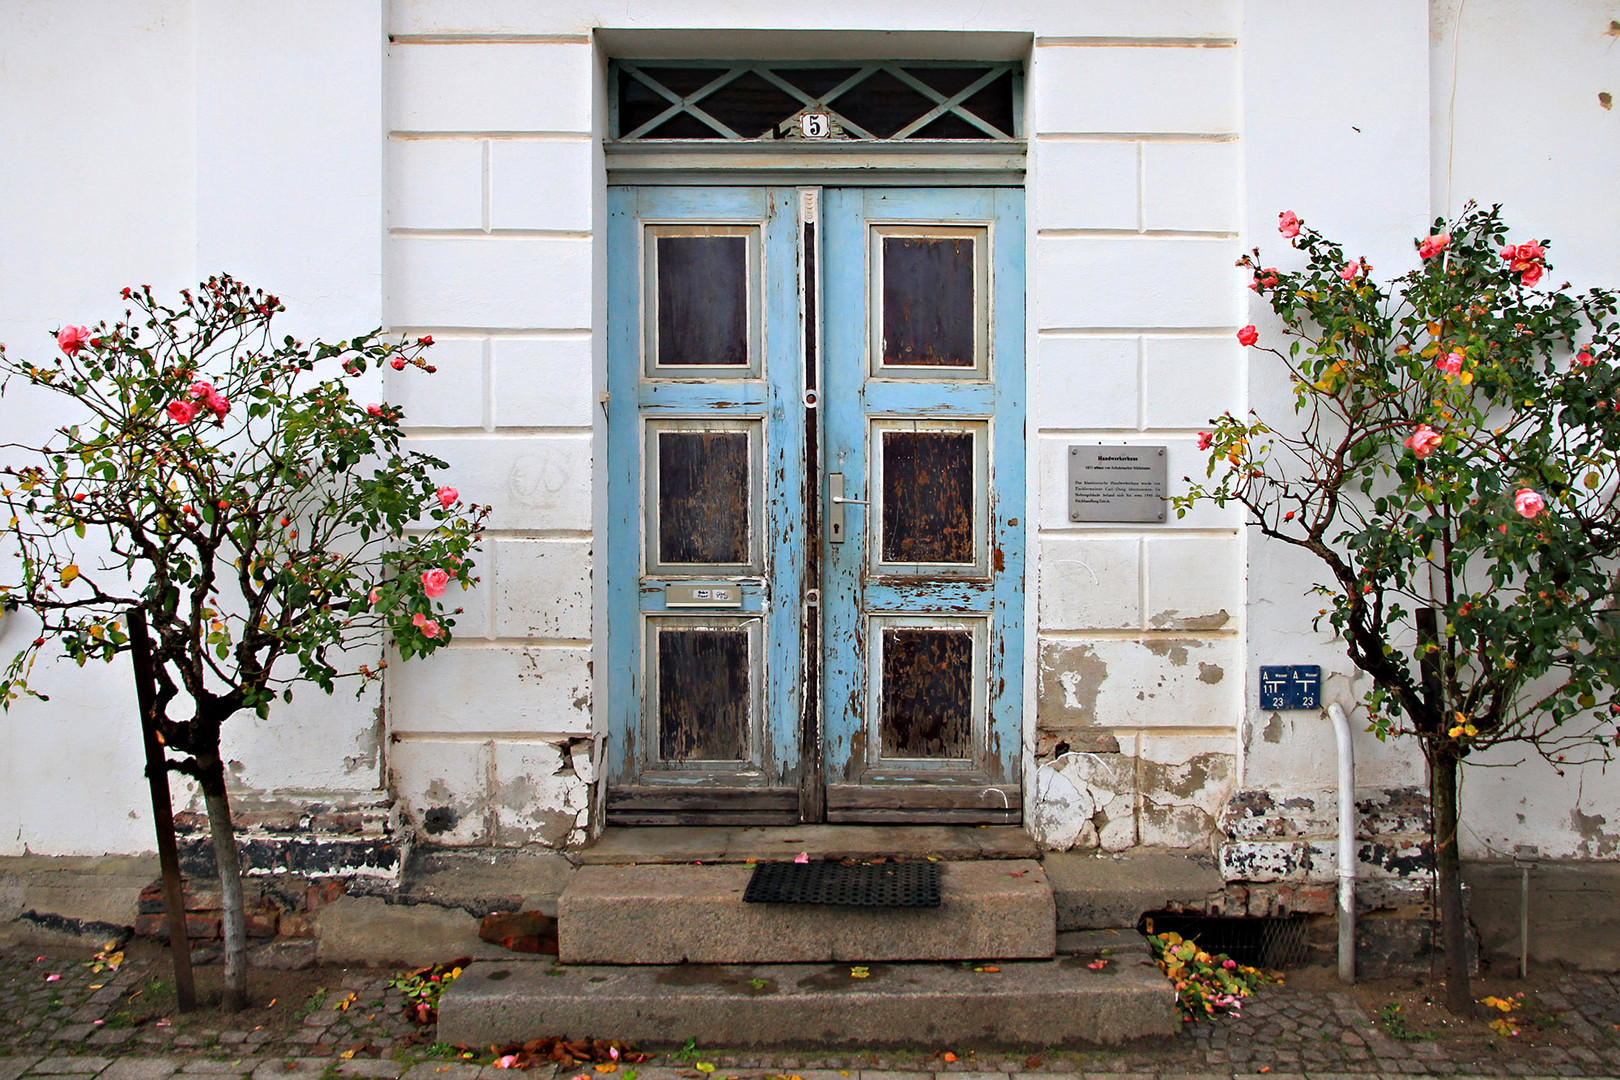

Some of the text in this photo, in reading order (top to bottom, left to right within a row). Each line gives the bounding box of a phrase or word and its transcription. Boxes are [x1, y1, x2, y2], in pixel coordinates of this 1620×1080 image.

[809, 115, 821, 135] 5
[1262, 671, 1269, 680] A
[1292, 670, 1299, 679] A
